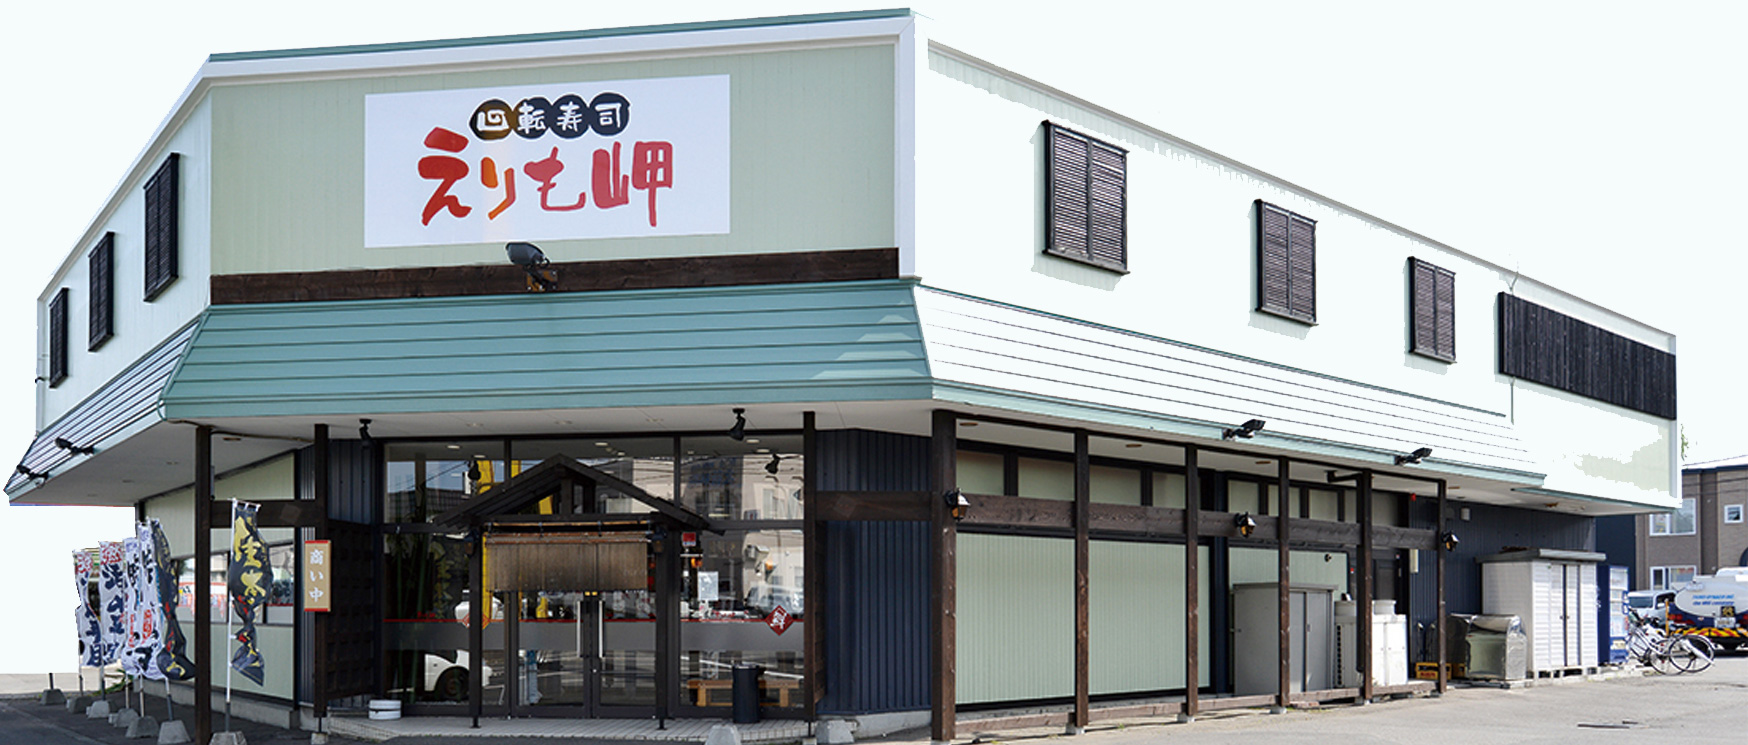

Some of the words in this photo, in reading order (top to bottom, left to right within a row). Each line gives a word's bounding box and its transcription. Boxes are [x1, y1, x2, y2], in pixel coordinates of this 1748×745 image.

[474, 99, 624, 135] 回転寿司
[417, 126, 674, 228] えりも岬
[308, 548, 324, 603] 商い中
